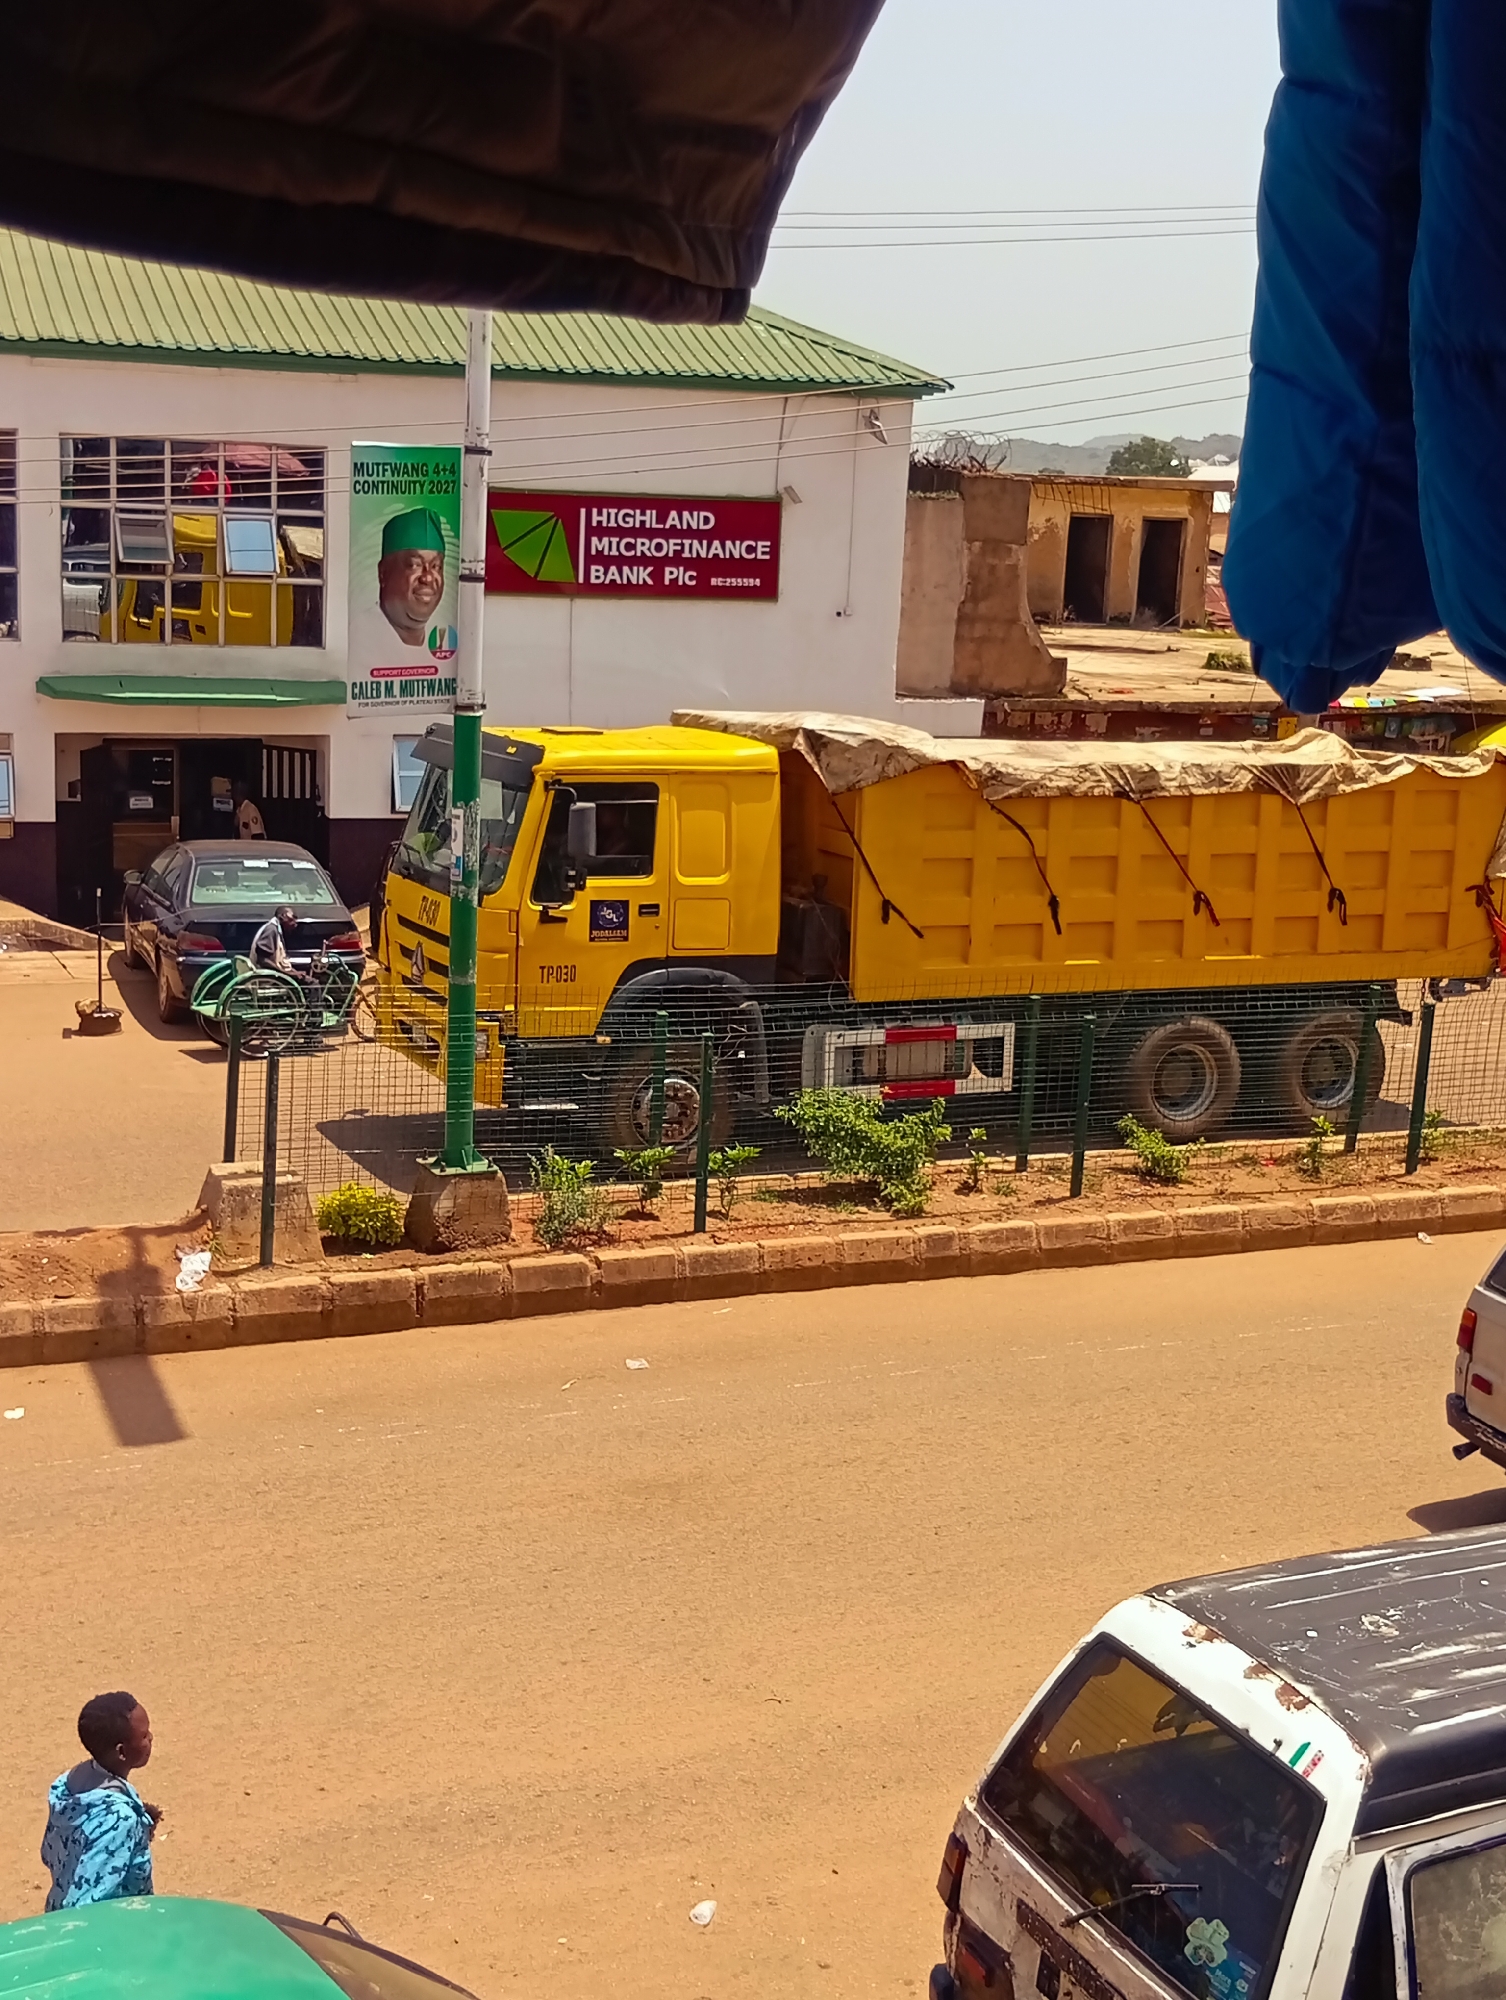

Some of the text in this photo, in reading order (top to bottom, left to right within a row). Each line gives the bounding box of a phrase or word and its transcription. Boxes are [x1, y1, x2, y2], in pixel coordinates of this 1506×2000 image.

[353, 462, 456, 478] MUTFWANG 4+4
[353, 480, 457, 495] CONTINUITY 2027
[591, 507, 716, 530] HIGHLAND
[590, 536, 772, 560] MICROFINANCE
[589, 564, 698, 586] BANK Plc
[373, 667, 436, 677] SUPPORT GOVERNOR
[351, 678, 457, 700] CALEB M. MUTFWANG
[370, 700, 400, 708] GOVERNOR
[538, 964, 577, 984] TP-030
